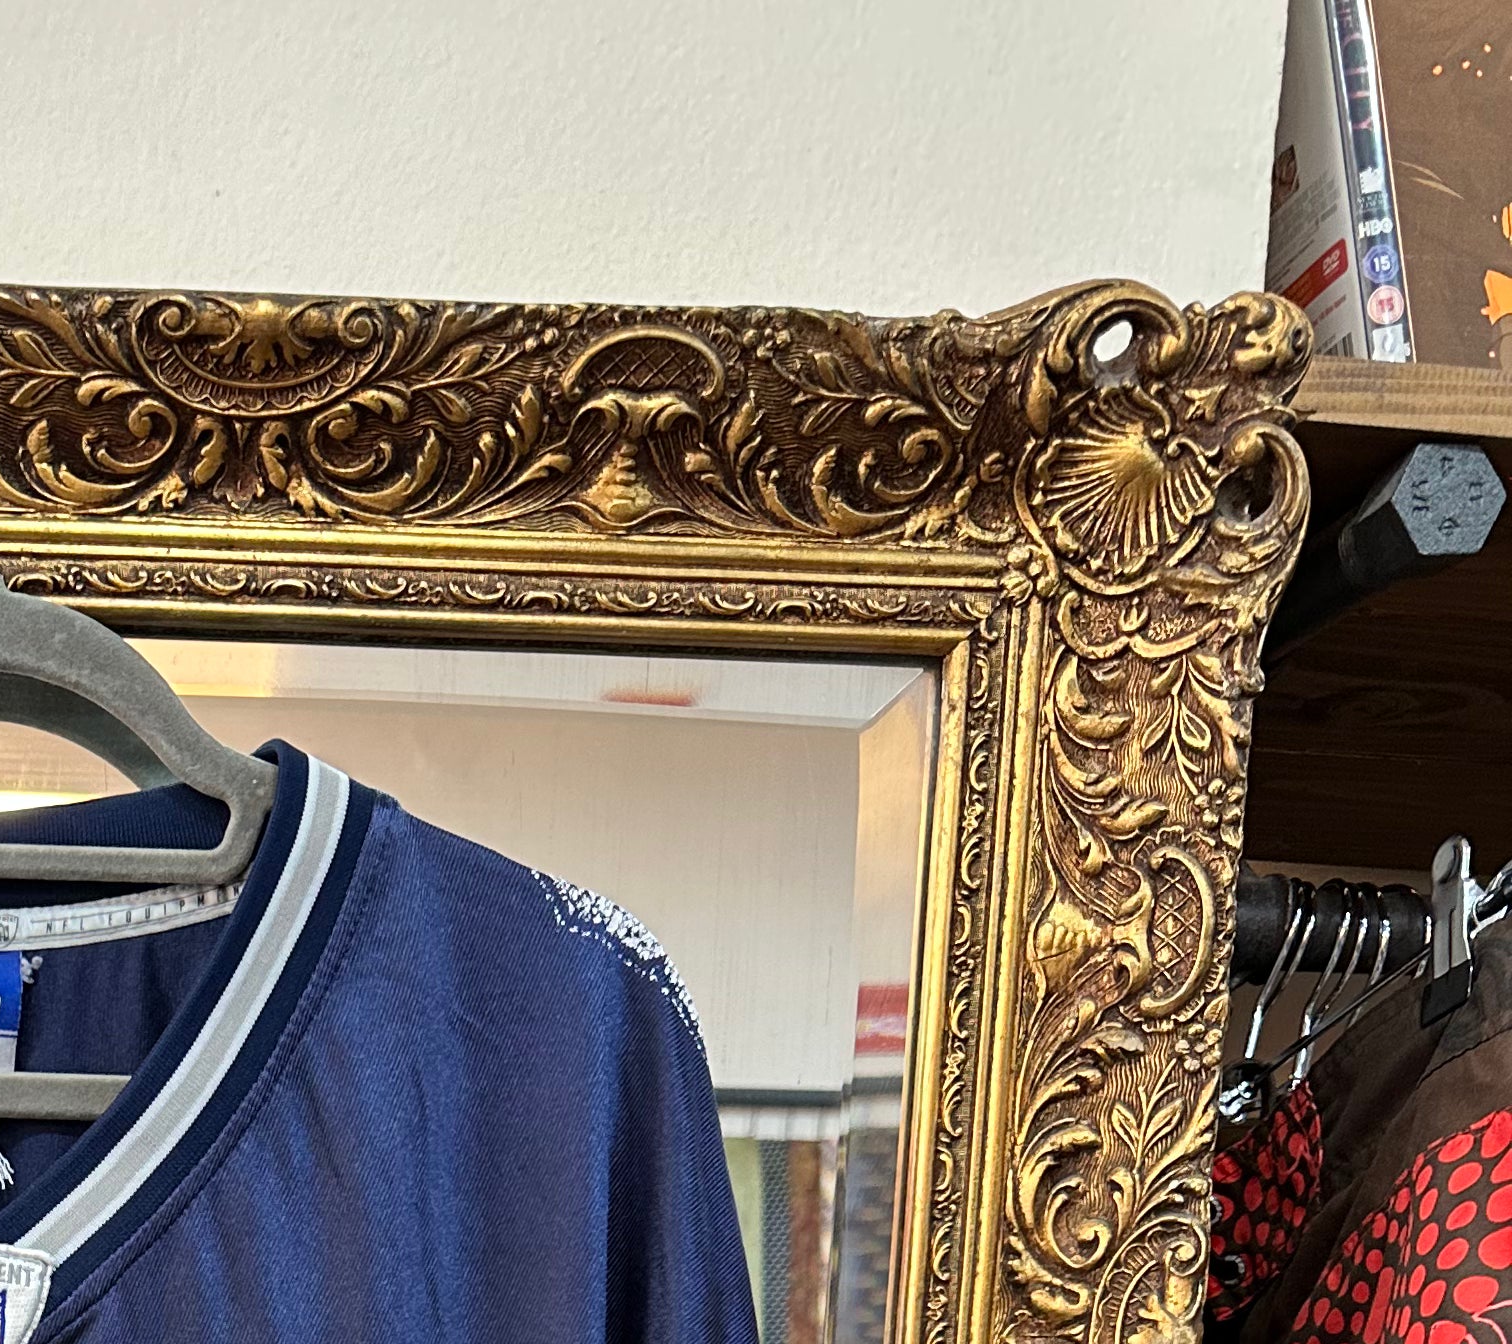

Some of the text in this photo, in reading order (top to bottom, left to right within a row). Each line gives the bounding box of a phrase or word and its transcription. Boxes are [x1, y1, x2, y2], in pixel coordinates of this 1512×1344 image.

[1357, 217, 1393, 240] HBO
[1373, 255, 1391, 272] 15
[45, 918, 85, 933] NFL
